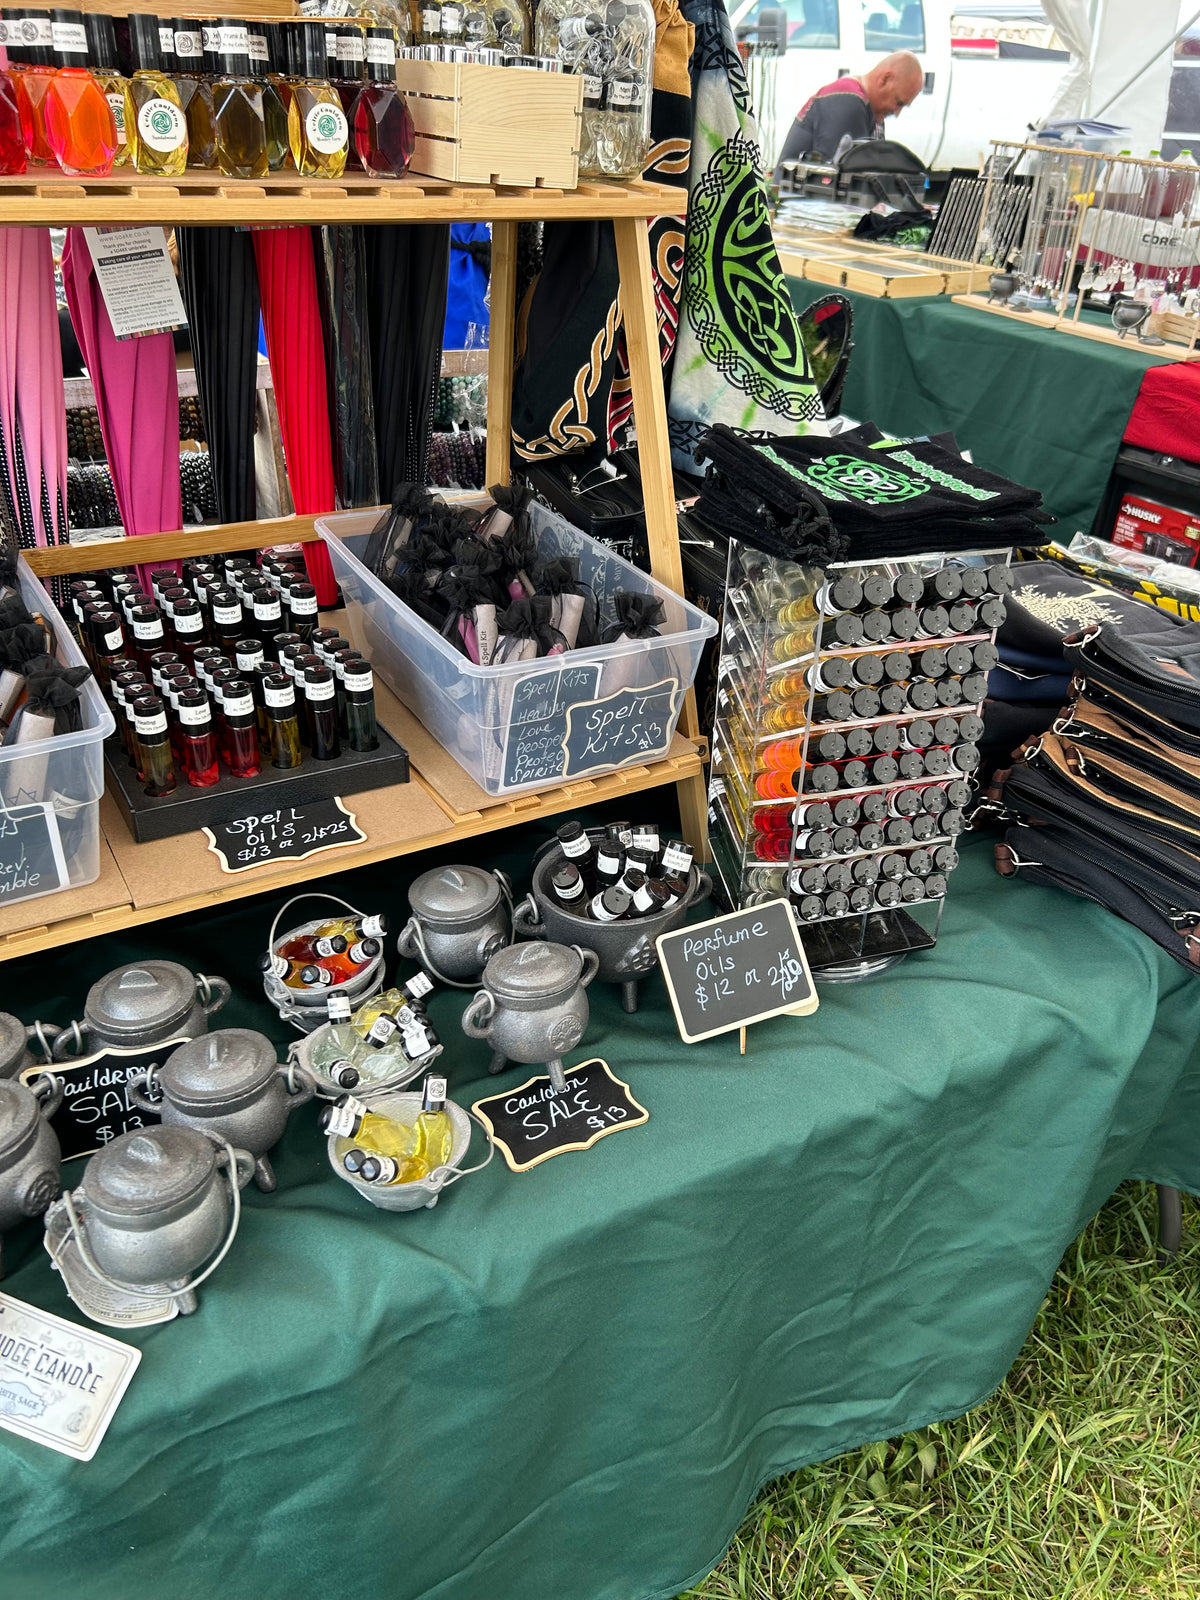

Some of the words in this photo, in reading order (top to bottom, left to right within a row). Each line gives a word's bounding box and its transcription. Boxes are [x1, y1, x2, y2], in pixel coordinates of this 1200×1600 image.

[1142, 233, 1177, 247] CORE
[1131, 506, 1162, 524] HUSKY
[480, 643, 490, 661] Spell
[518, 675, 557, 703] Spell
[562, 669, 590, 687] Kits
[518, 724, 556, 741] Love
[237, 845, 272, 861] $13
[683, 921, 769, 962] Perfume
[696, 956, 736, 981] Oils
[694, 978, 735, 1011] $12
[745, 968, 761, 986] or
[522, 1089, 602, 1141] SALE
[586, 1105, 627, 1129] $13
[34, 1352, 103, 1395] CANDLE
[17, 1395, 39, 1410] SAGE
